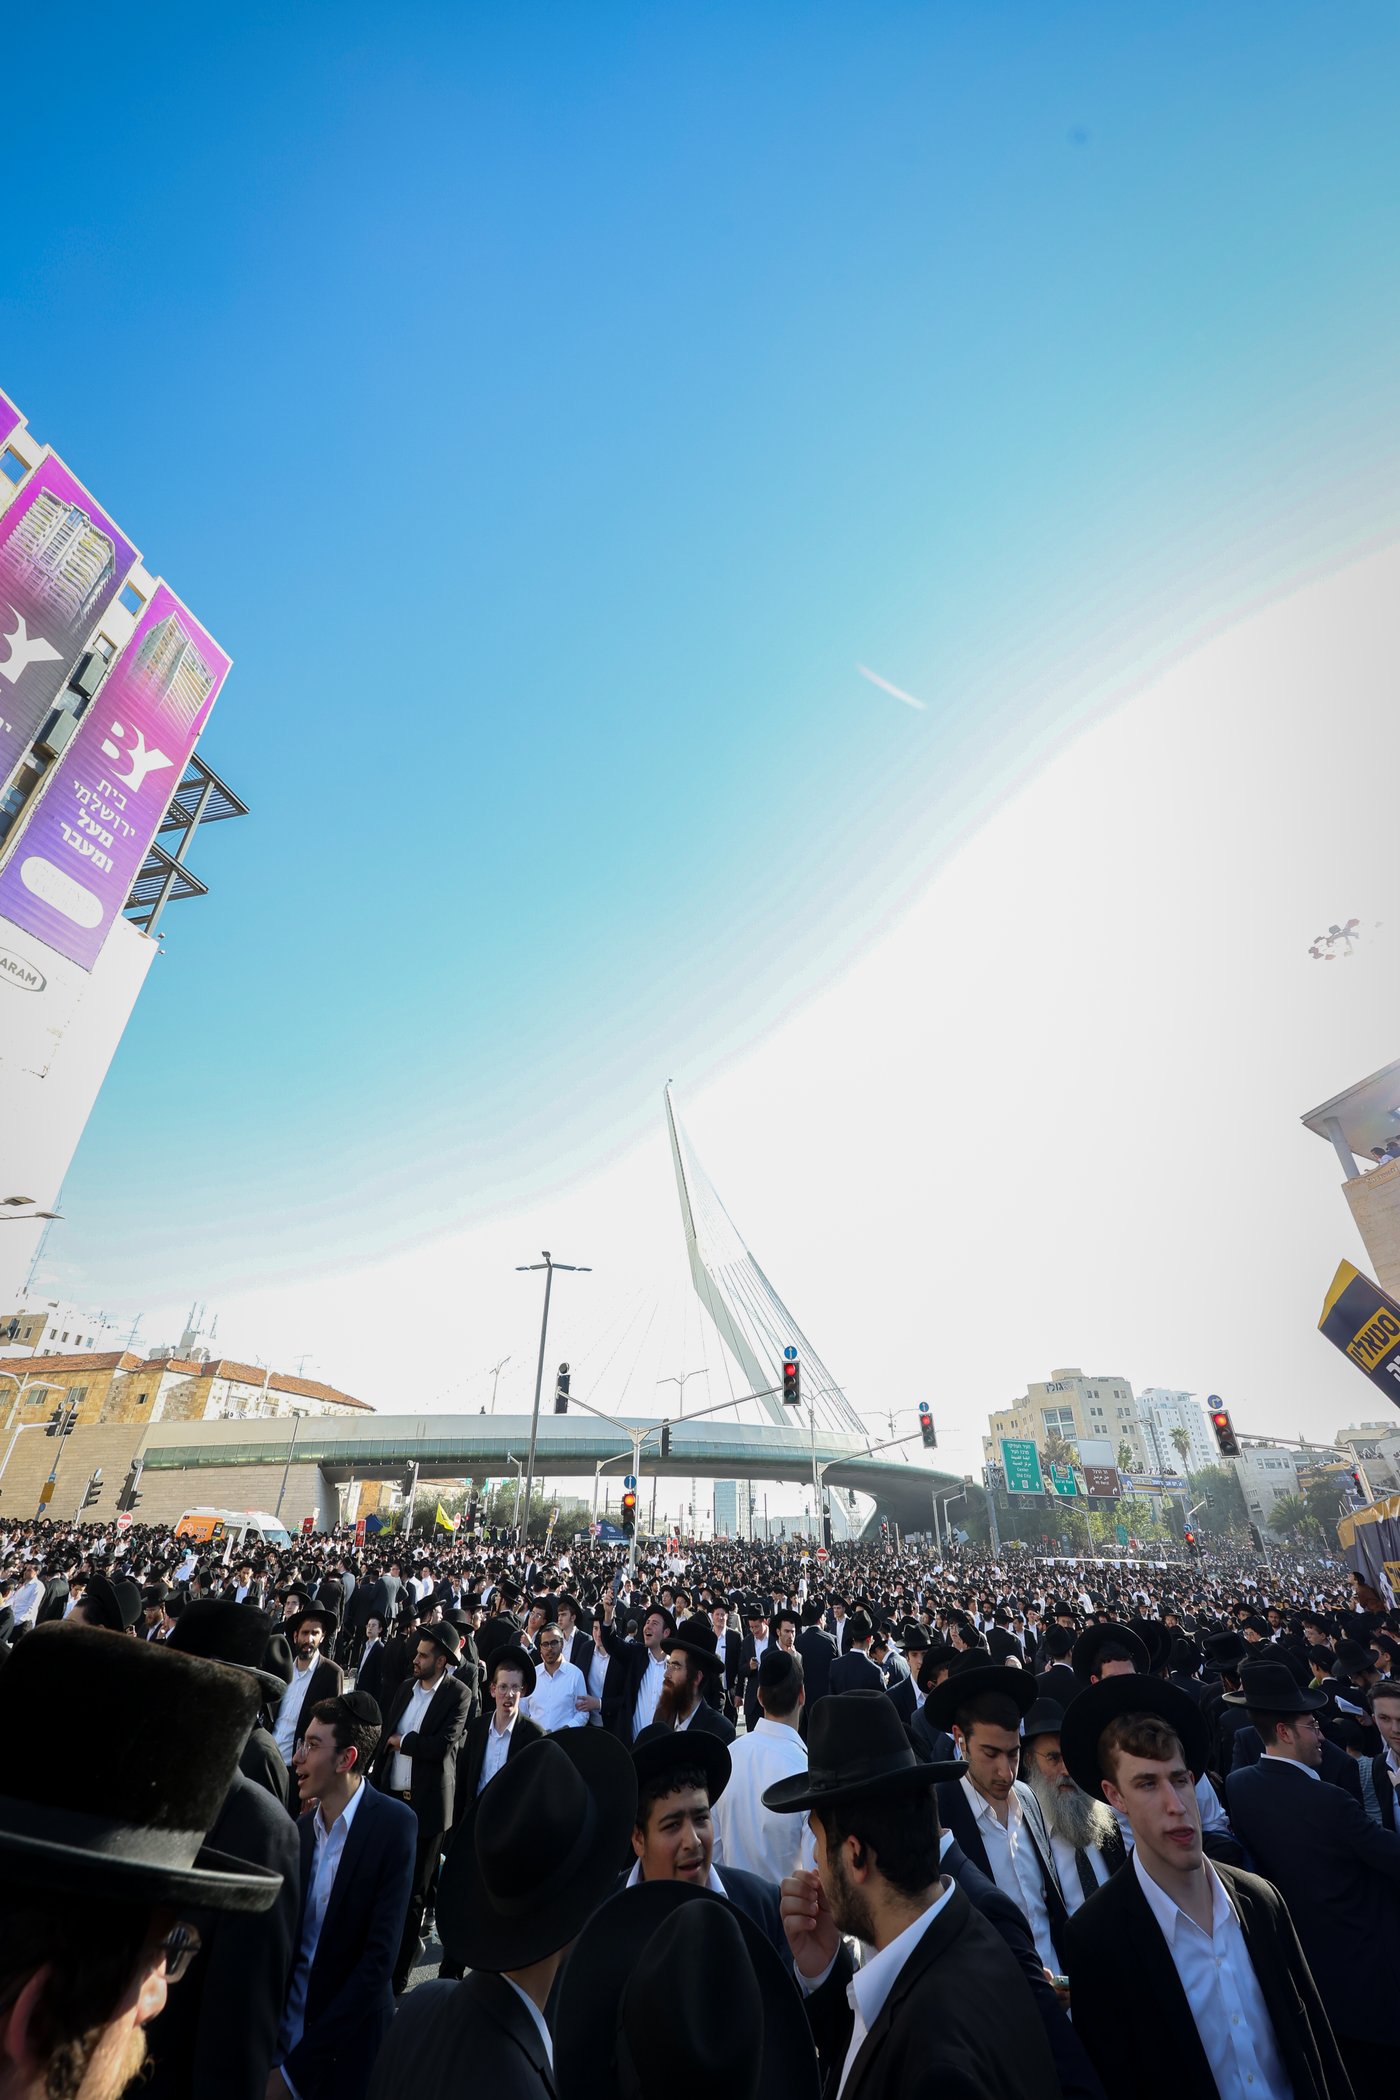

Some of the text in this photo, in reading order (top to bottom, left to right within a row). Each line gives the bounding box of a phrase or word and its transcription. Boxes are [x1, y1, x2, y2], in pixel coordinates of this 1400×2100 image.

[101, 720, 175, 793] BY
[73, 780, 136, 838] ירושלמי
[96, 778, 128, 811] בית
[60, 821, 114, 874] ומעבר
[76, 807, 115, 849] מעל
